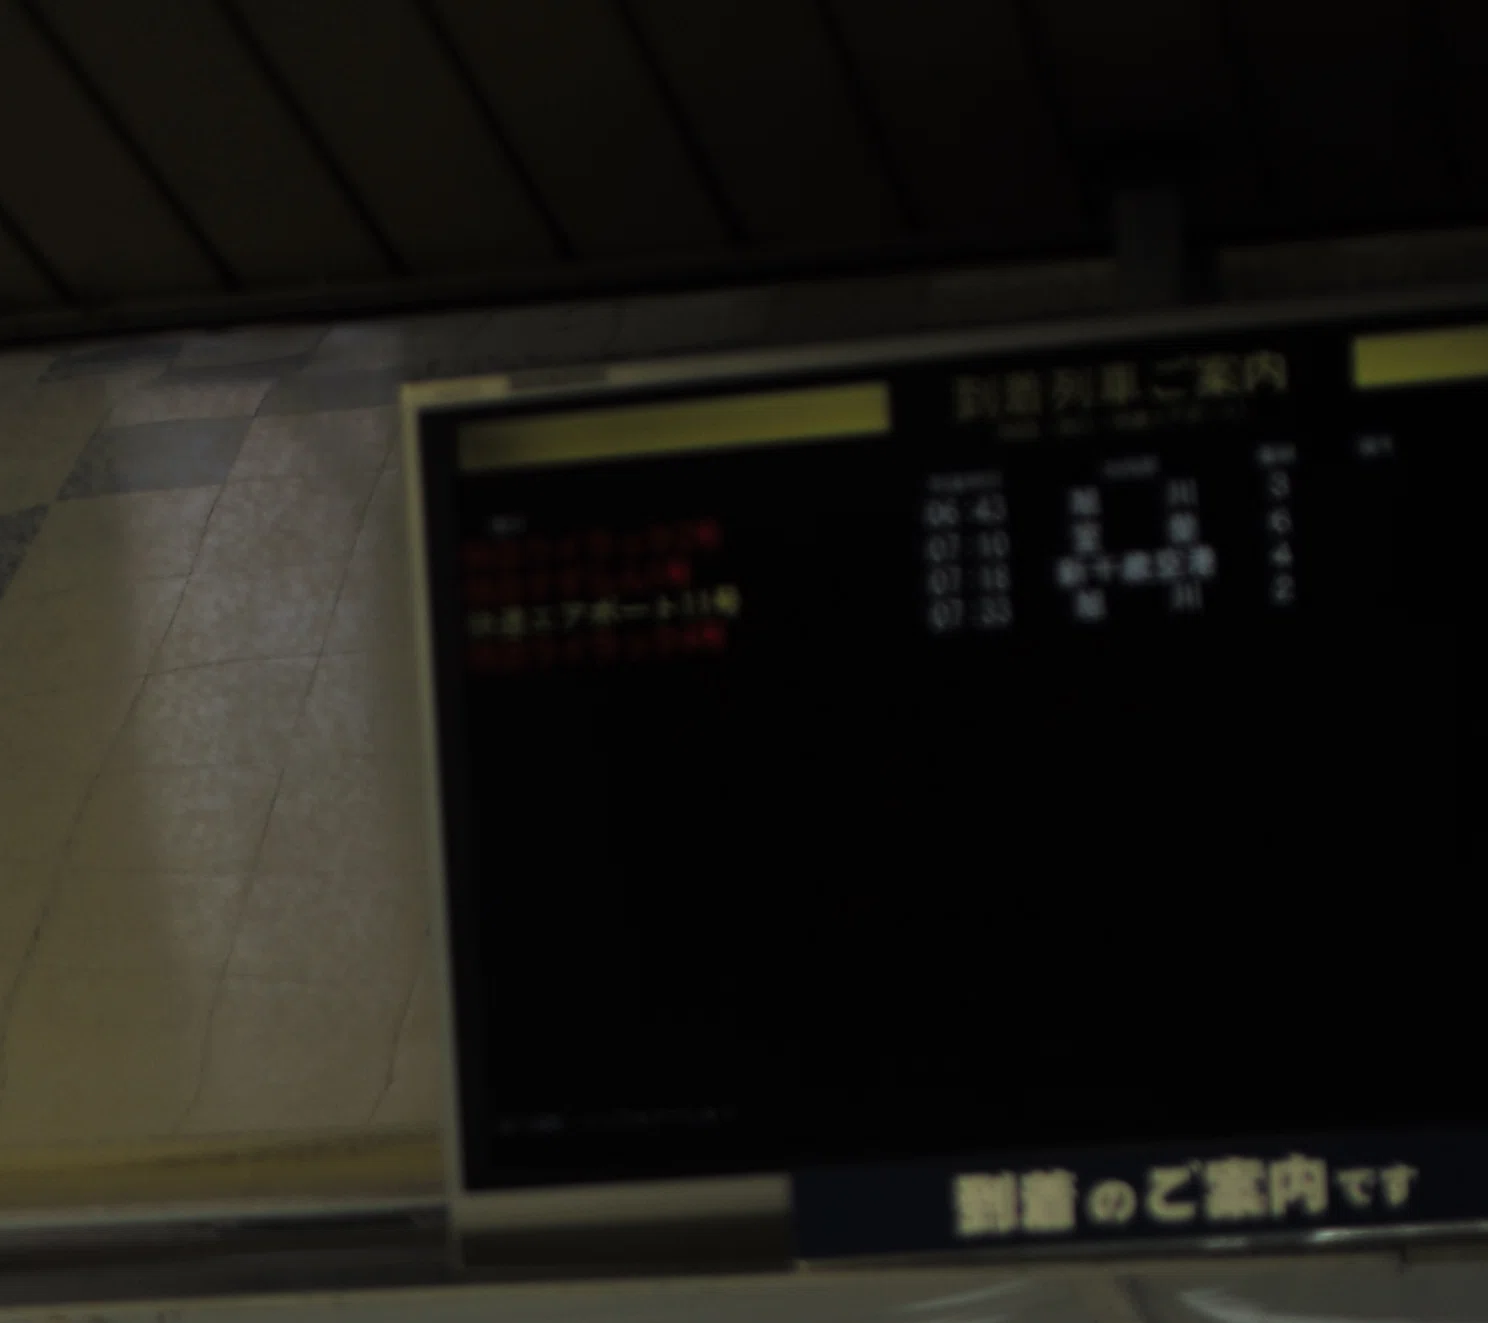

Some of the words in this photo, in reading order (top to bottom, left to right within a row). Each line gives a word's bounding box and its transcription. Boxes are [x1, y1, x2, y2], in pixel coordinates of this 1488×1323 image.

[949, 1150, 1420, 1241] 到着のご案内です
